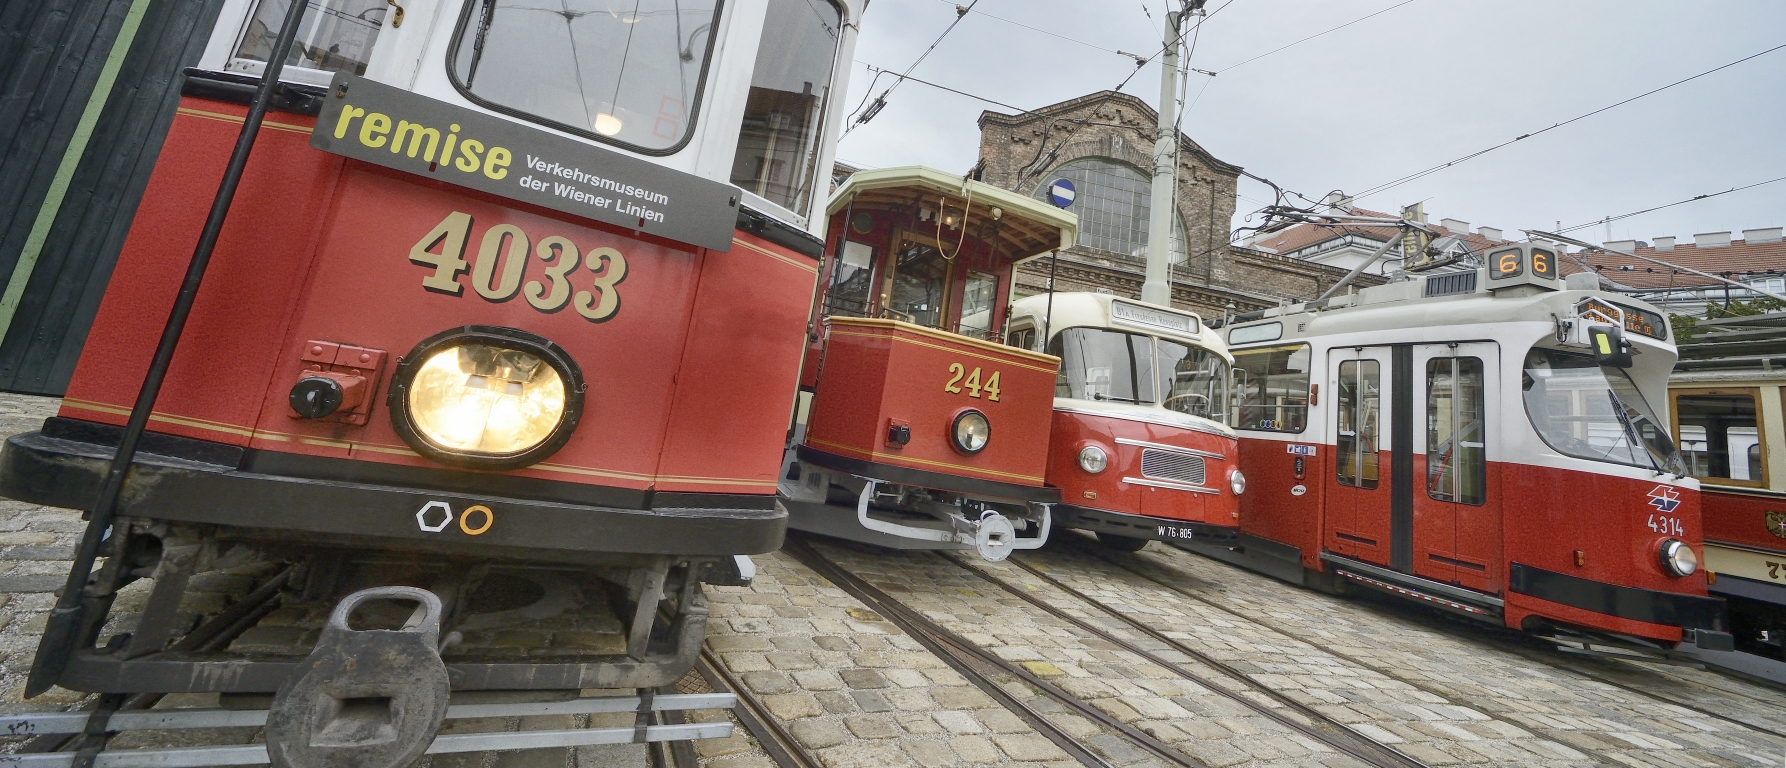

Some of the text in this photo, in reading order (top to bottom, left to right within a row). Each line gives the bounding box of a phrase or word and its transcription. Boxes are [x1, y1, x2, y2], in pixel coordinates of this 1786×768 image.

[333, 104, 512, 180] remise
[526, 154, 669, 206] Verkehrsmuseum
[519, 175, 665, 223] der Wiener Linien
[408, 210, 629, 324] 4033
[1499, 253, 1517, 273] 6
[1533, 253, 1547, 273] 6
[1587, 302, 1645, 323] Burggsse
[944, 362, 1001, 402] 244
[1157, 525, 1166, 536] W
[1647, 513, 1684, 537] 4314
